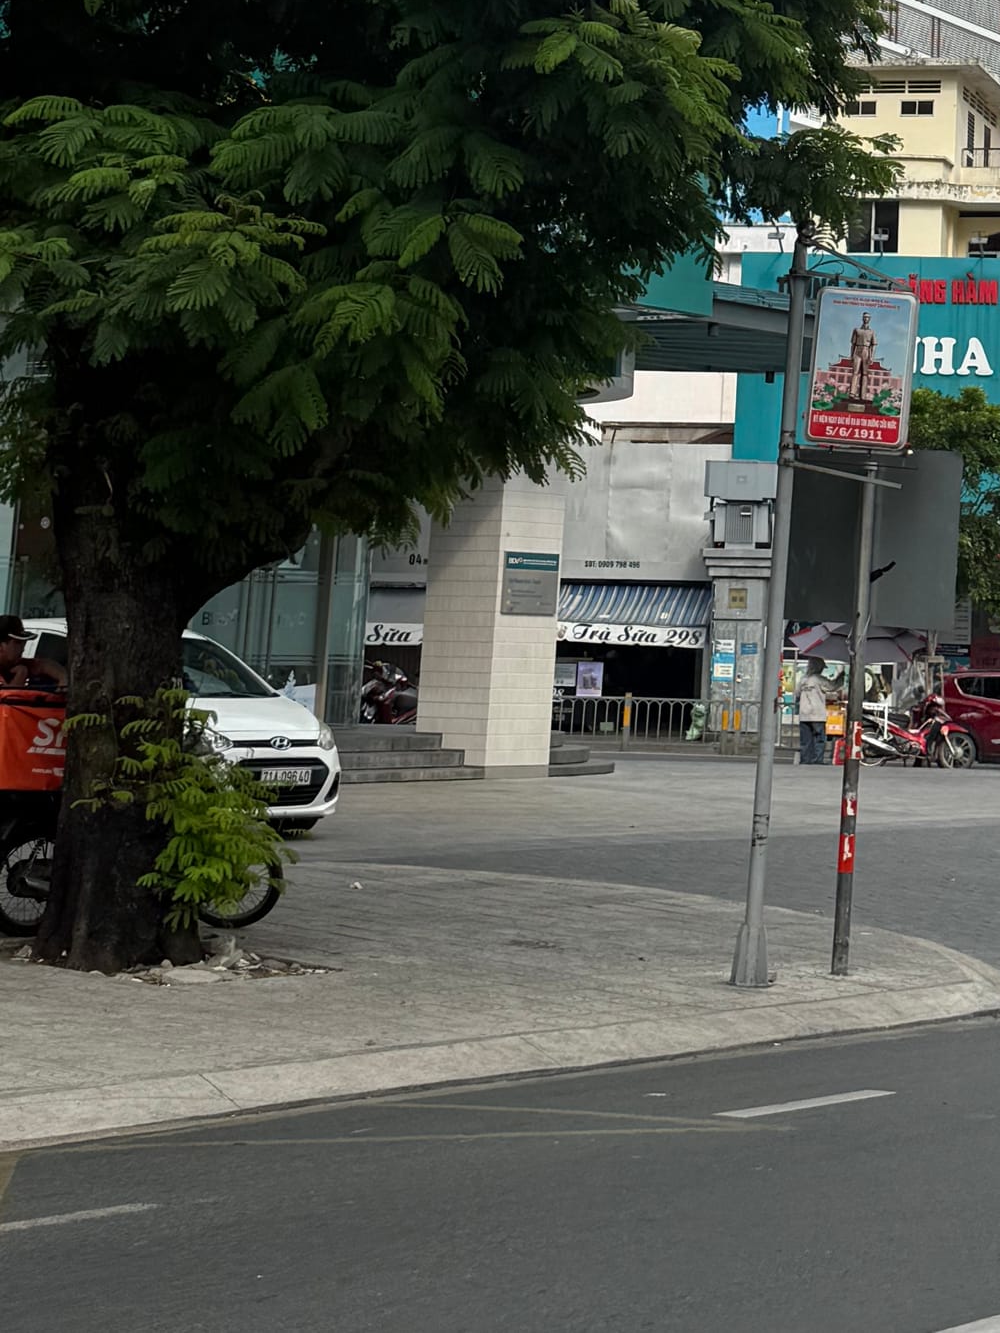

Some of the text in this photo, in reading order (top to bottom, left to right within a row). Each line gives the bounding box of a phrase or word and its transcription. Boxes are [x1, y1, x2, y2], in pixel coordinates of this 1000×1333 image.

[893, 274, 947, 305] ĂNG
[951, 273, 999, 306] HÀM
[825, 426, 883, 441] 5/6/1911
[572, 623, 610, 641] Trà
[617, 624, 660, 644] Sữa
[663, 629, 703, 647] 298
